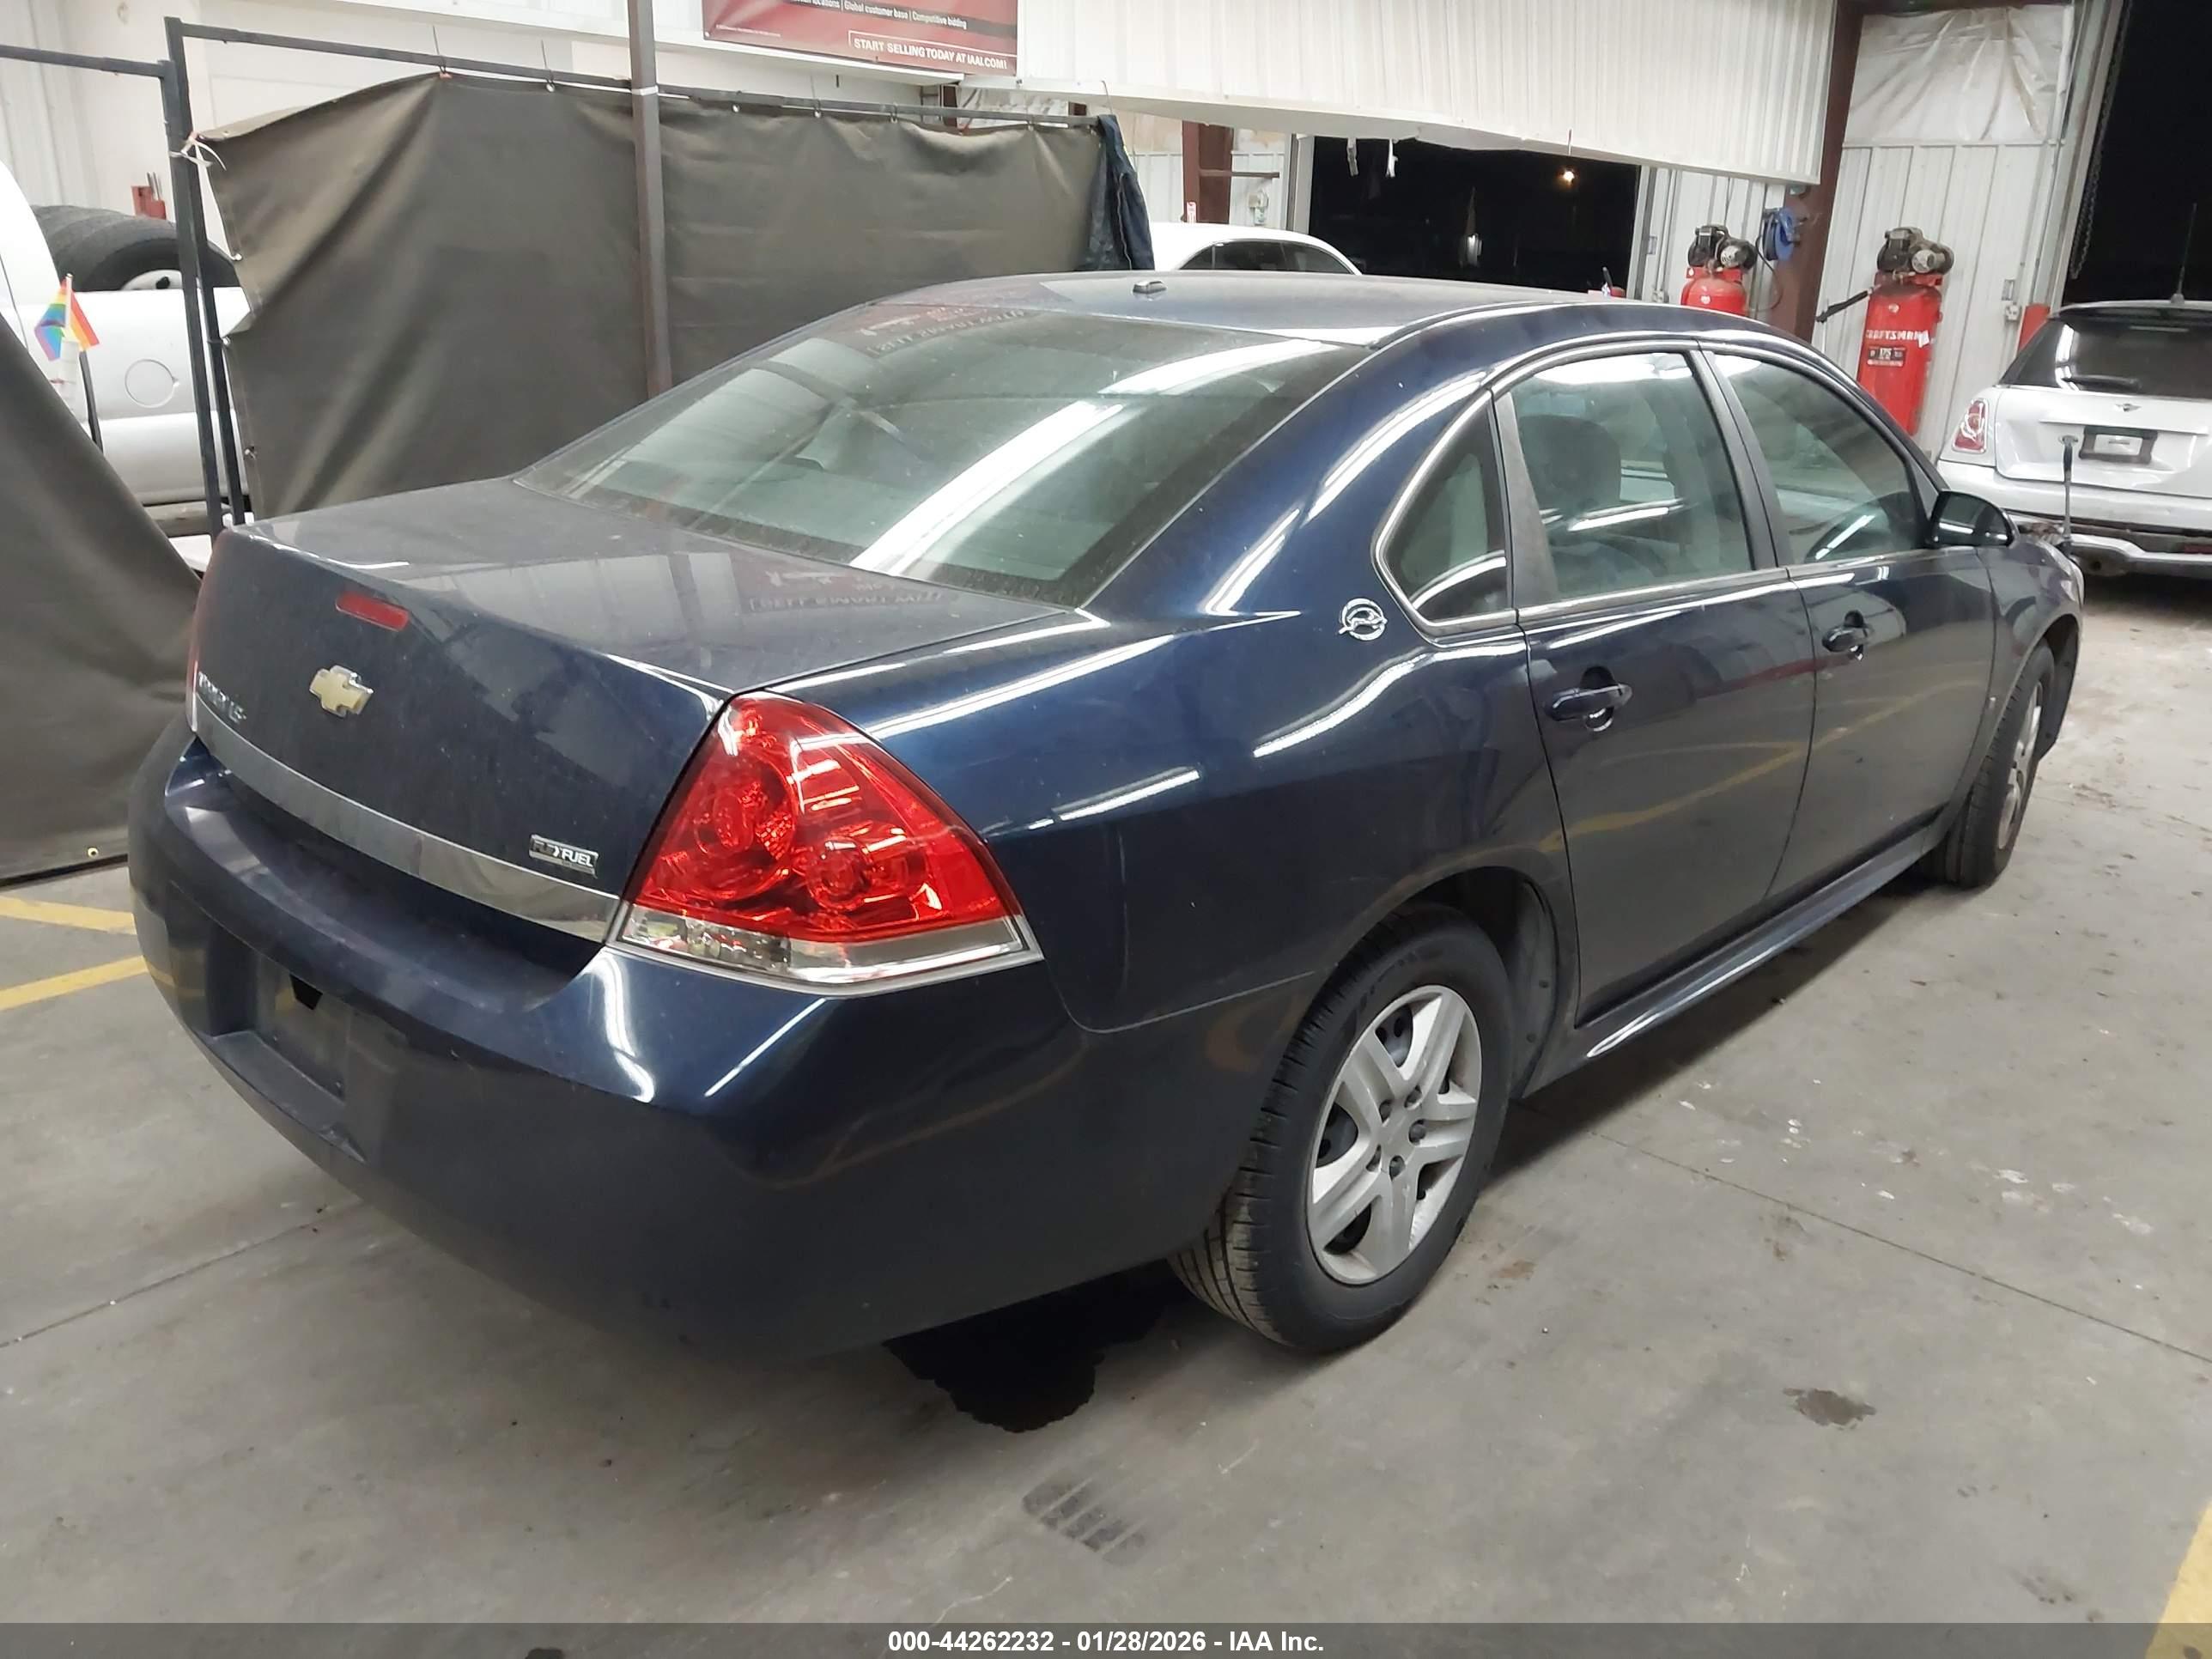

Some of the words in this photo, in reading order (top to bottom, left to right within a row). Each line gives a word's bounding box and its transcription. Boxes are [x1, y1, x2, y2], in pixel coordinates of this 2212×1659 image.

[912, 11, 947, 26] Competitive
[947, 16, 967, 29] bidding
[854, 38, 884, 52] START
[887, 45, 926, 58] SELLING
[927, 49, 955, 63] TODAY
[956, 53, 967, 64] AT
